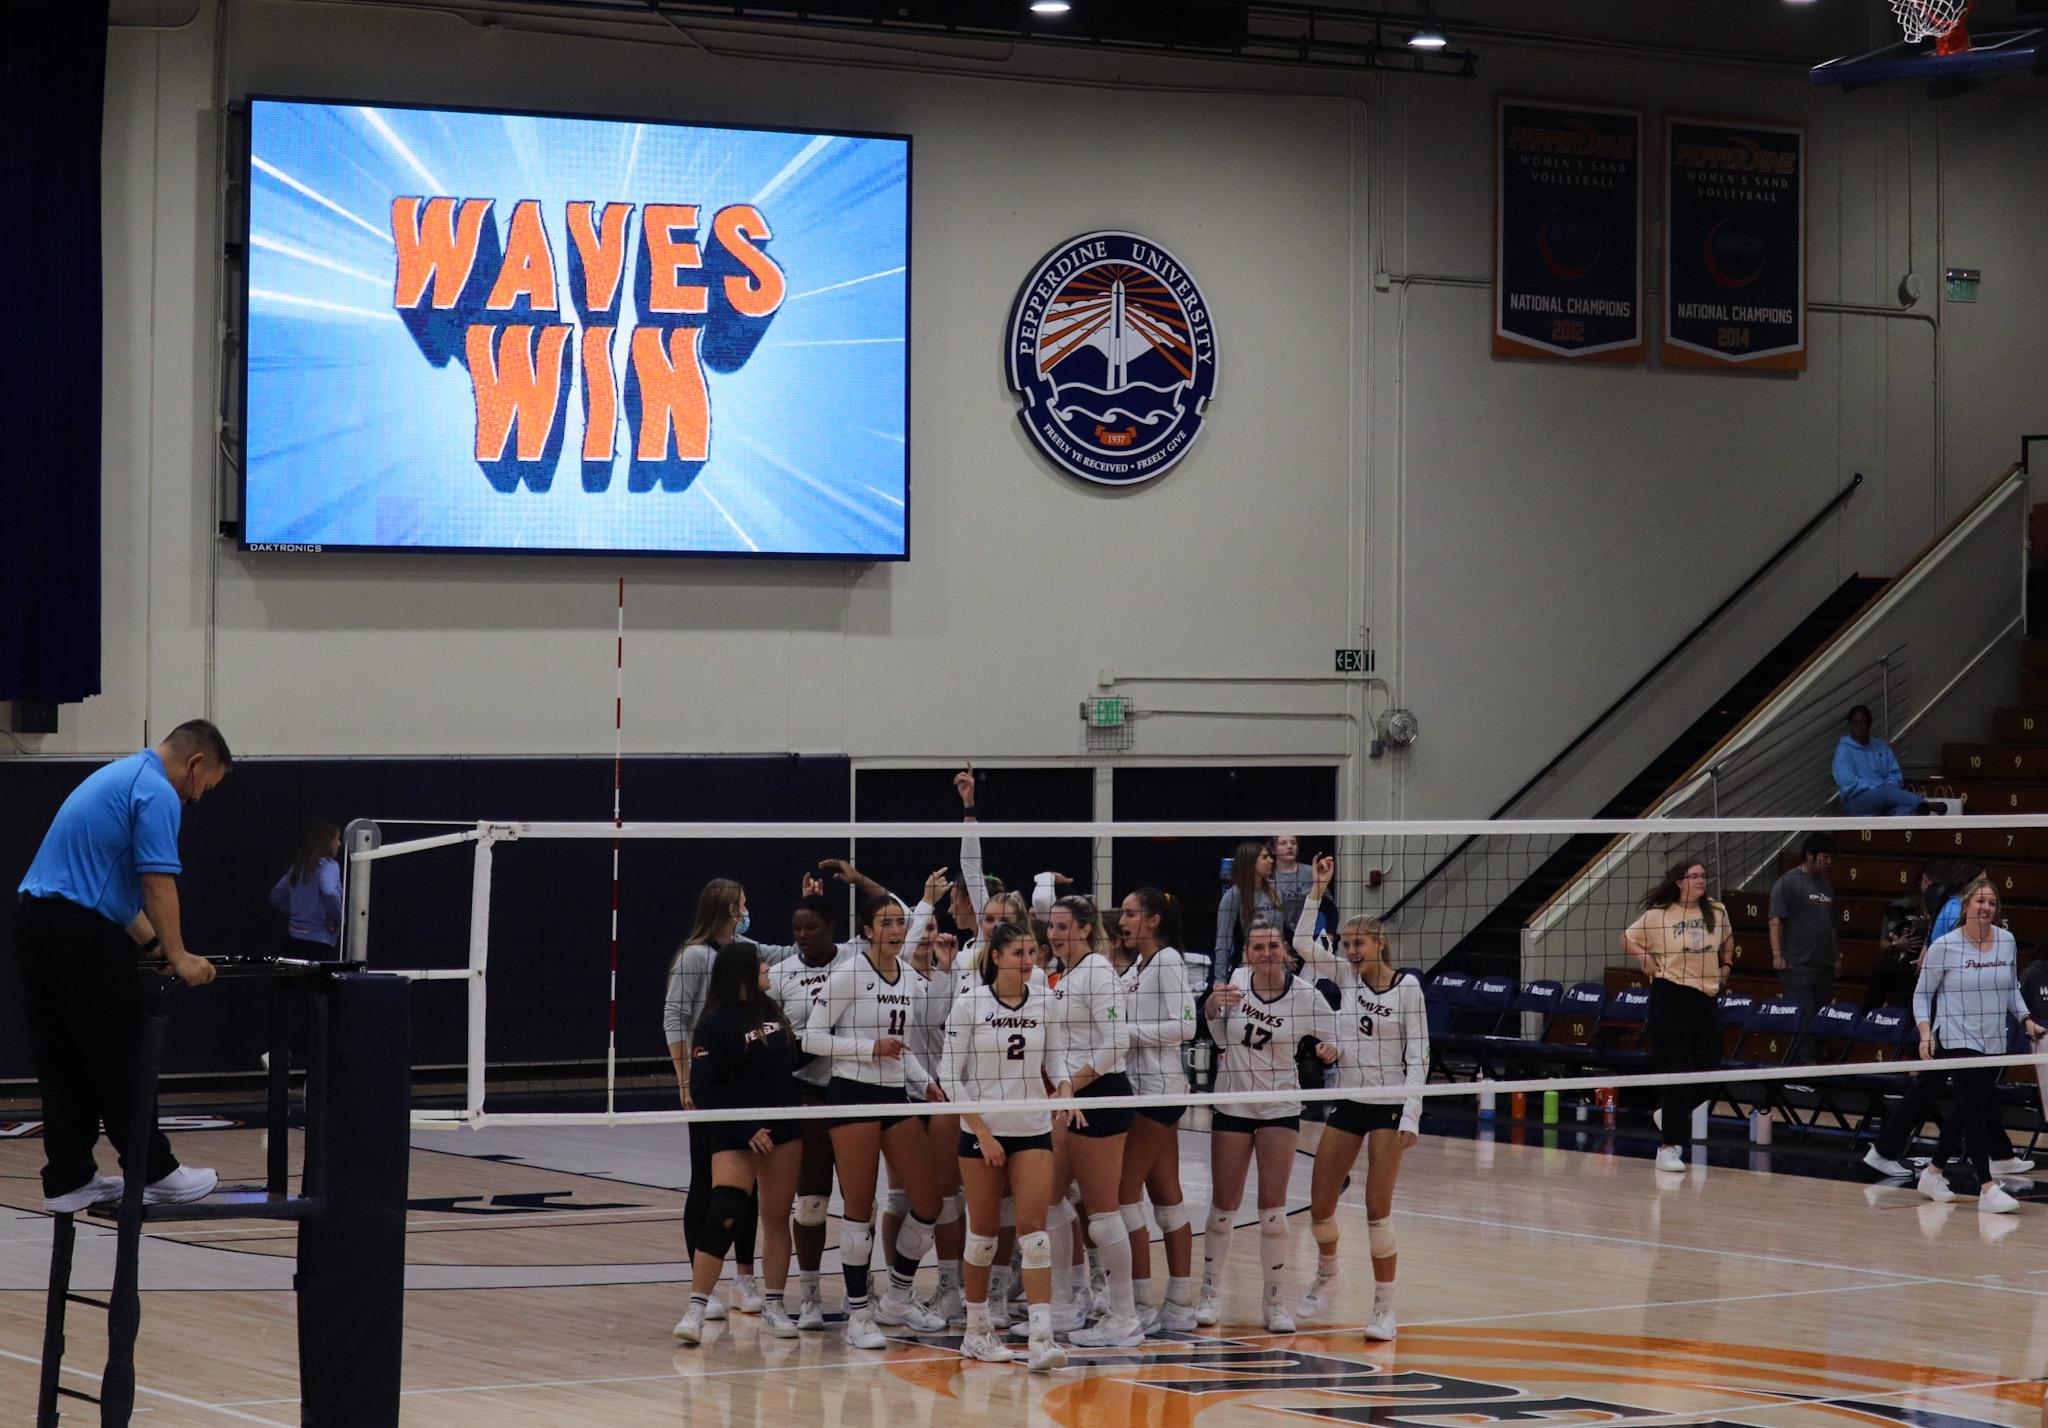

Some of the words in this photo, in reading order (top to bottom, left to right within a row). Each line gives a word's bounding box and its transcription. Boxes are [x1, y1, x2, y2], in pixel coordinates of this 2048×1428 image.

[1530, 171, 1616, 188] VOLLEYBALL
[1754, 177, 1789, 189] SAND
[1697, 186, 1777, 202] VOLLEYBALL
[391, 195, 787, 318] WAVES
[1019, 241, 1108, 355] PEPPERDINE
[1131, 243, 1213, 366] UNIVERSITY
[1510, 293, 1564, 312] NATIONAL
[1567, 297, 1632, 318] CHAMPIONS
[1677, 303, 1729, 321] NATIONAL
[1732, 306, 1793, 325] CHAMPIONS
[1717, 326, 1750, 348] 2014
[464, 323, 712, 463] WIN
[1107, 434, 1126, 444] 1937
[1043, 423, 1072, 454] FREELY
[1071, 451, 1083, 462] YE
[1083, 456, 1129, 473] RECEIVED
[1137, 448, 1166, 470] FREELY
[1166, 430, 1187, 452] GIVE
[249, 543, 322, 553] DAKTRONICS
[2023, 718, 2034, 730] 10
[1970, 756, 1981, 768] 10
[2014, 756, 2022, 768] 9
[1960, 792, 1968, 804] 9
[2010, 794, 2018, 807] 8
[1861, 829, 1871, 842] 10
[1904, 830, 1912, 843] 9
[1954, 832, 1962, 845] 8
[2006, 835, 2014, 847] 7
[1849, 867, 1857, 881] 9
[1899, 871, 1907, 884] 8
[2005, 876, 2013, 889] 6
[1746, 903, 1757, 917] 10
[1842, 909, 1850, 922] 8
[1734, 945, 1742, 959] 9
[877, 994, 911, 1006] WAVES
[888, 1009, 906, 1036] 11
[1241, 1003, 1284, 1028] WAVES
[991, 1018, 1040, 1029] WAVES
[1359, 1015, 1374, 1037] 9
[1572, 1023, 1584, 1037] 10
[1241, 1022, 1273, 1051] 17
[1007, 1034, 1026, 1060] 2
[1769, 1039, 1777, 1053] 6
[1874, 1049, 1884, 1062] 4
